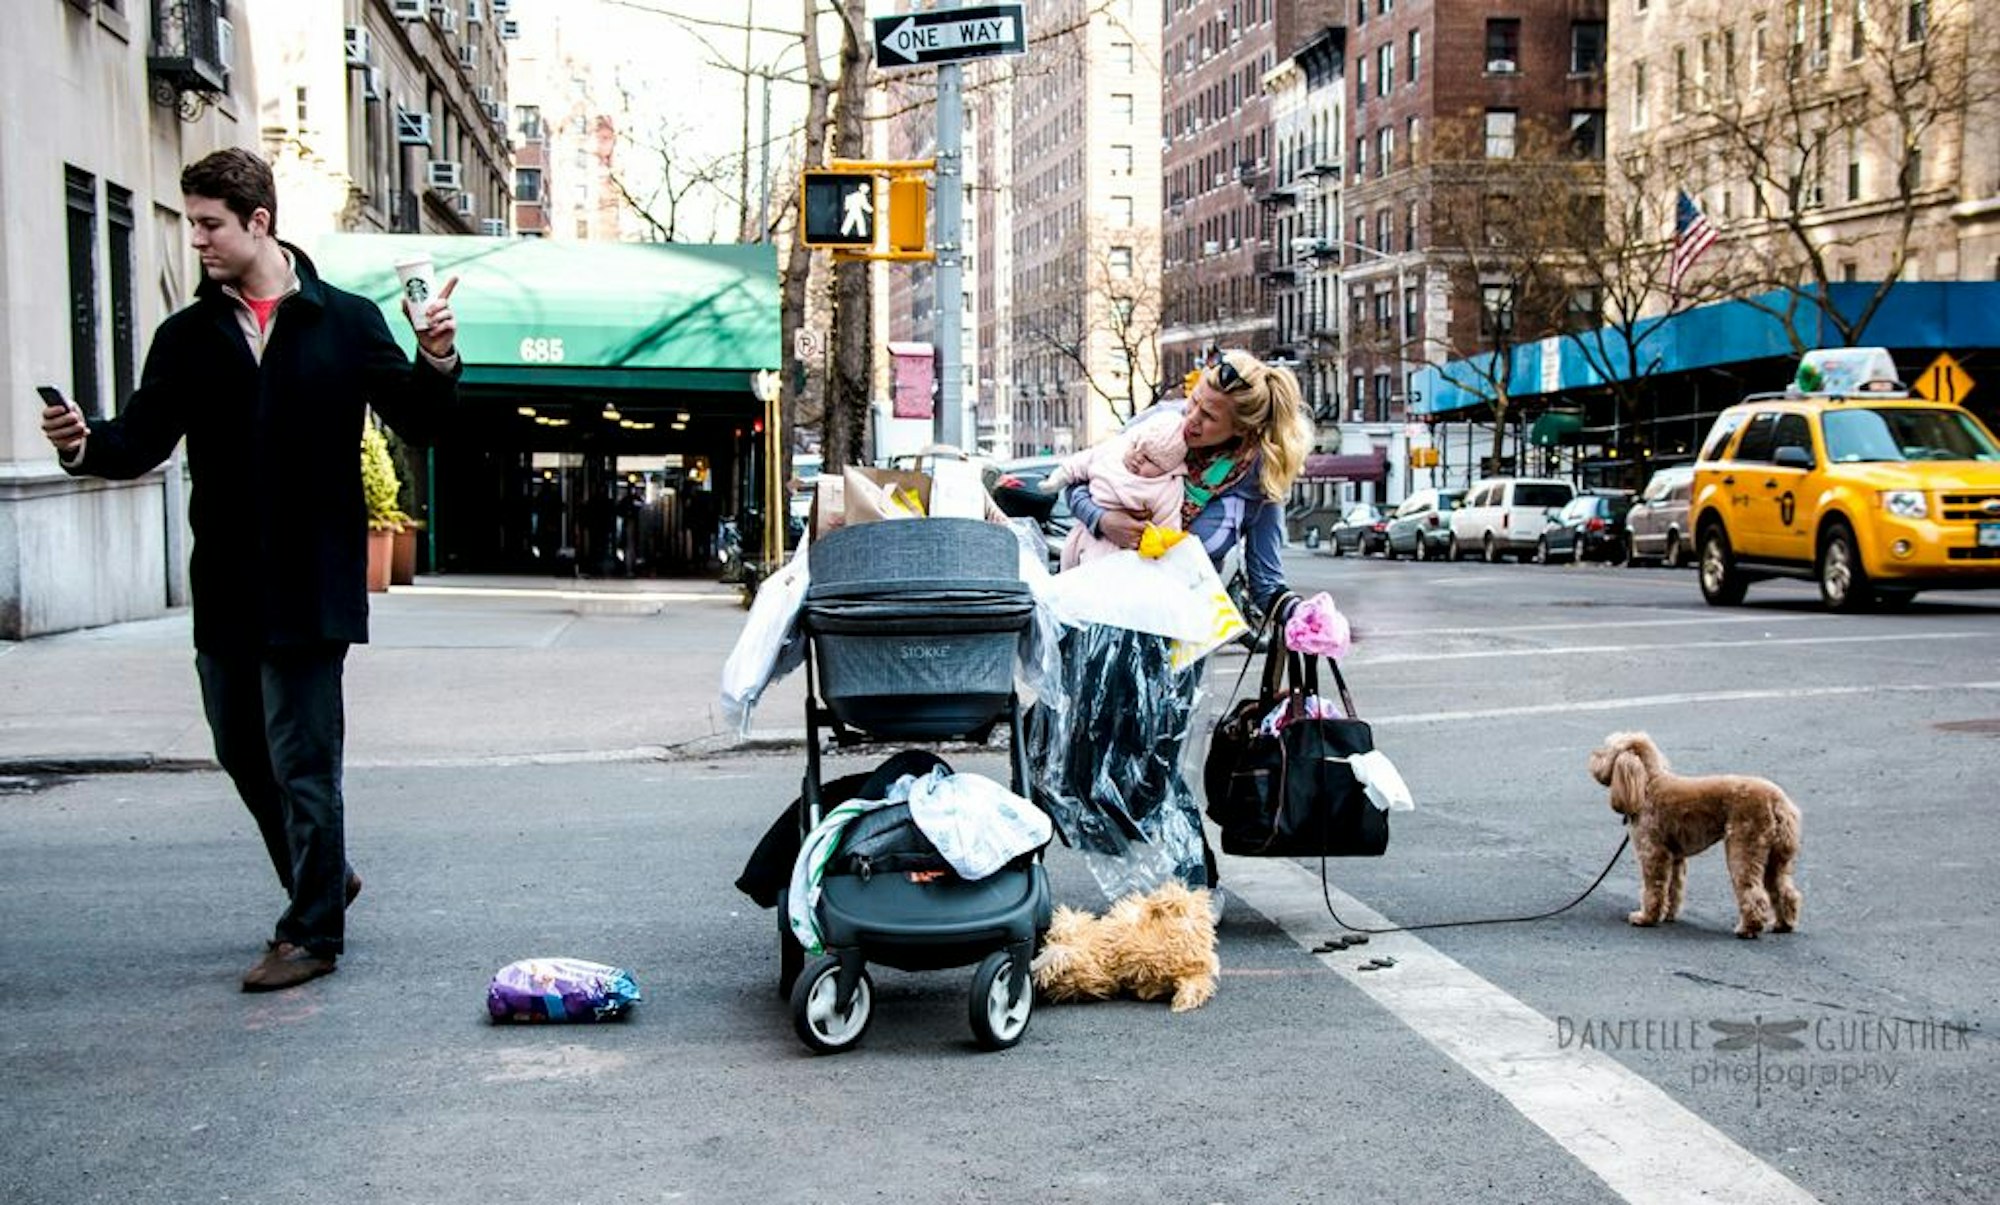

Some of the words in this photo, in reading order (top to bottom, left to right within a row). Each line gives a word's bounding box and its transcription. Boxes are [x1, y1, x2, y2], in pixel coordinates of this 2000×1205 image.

[898, 27, 939, 50] ONE
[959, 21, 1003, 43] WAY
[520, 336, 565, 363] 685
